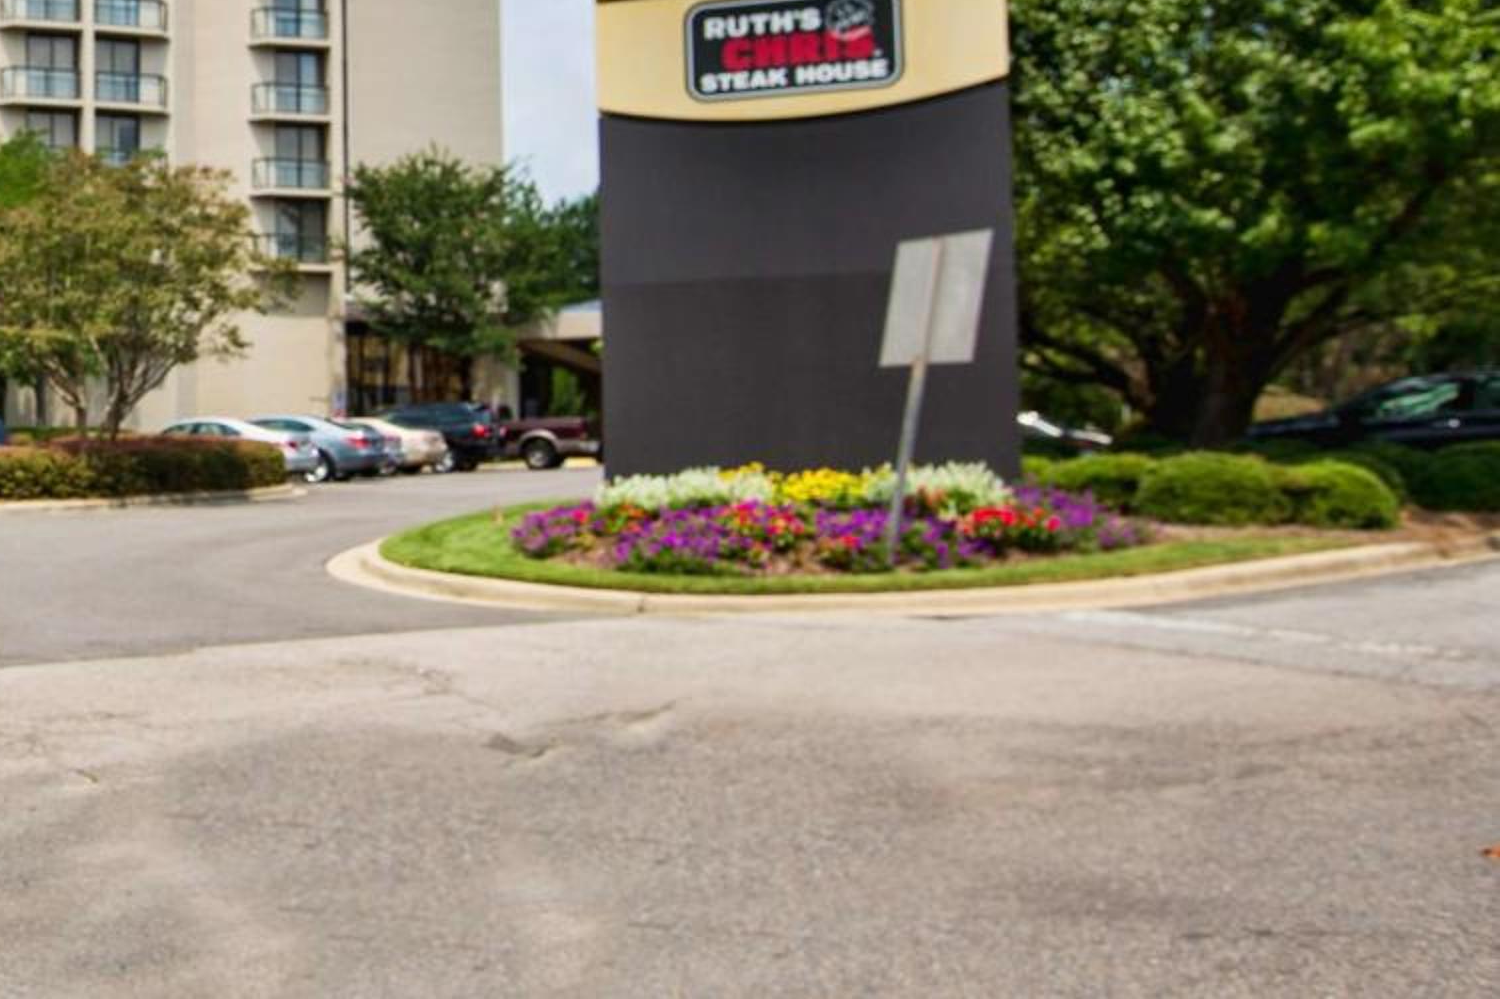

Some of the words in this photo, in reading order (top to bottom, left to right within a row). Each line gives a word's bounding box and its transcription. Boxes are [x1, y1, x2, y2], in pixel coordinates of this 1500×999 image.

[704, 7, 822, 39] RUTH'S
[721, 27, 875, 71] CHRIS
[700, 67, 788, 93] STEAK
[794, 57, 888, 85] HOUSE
